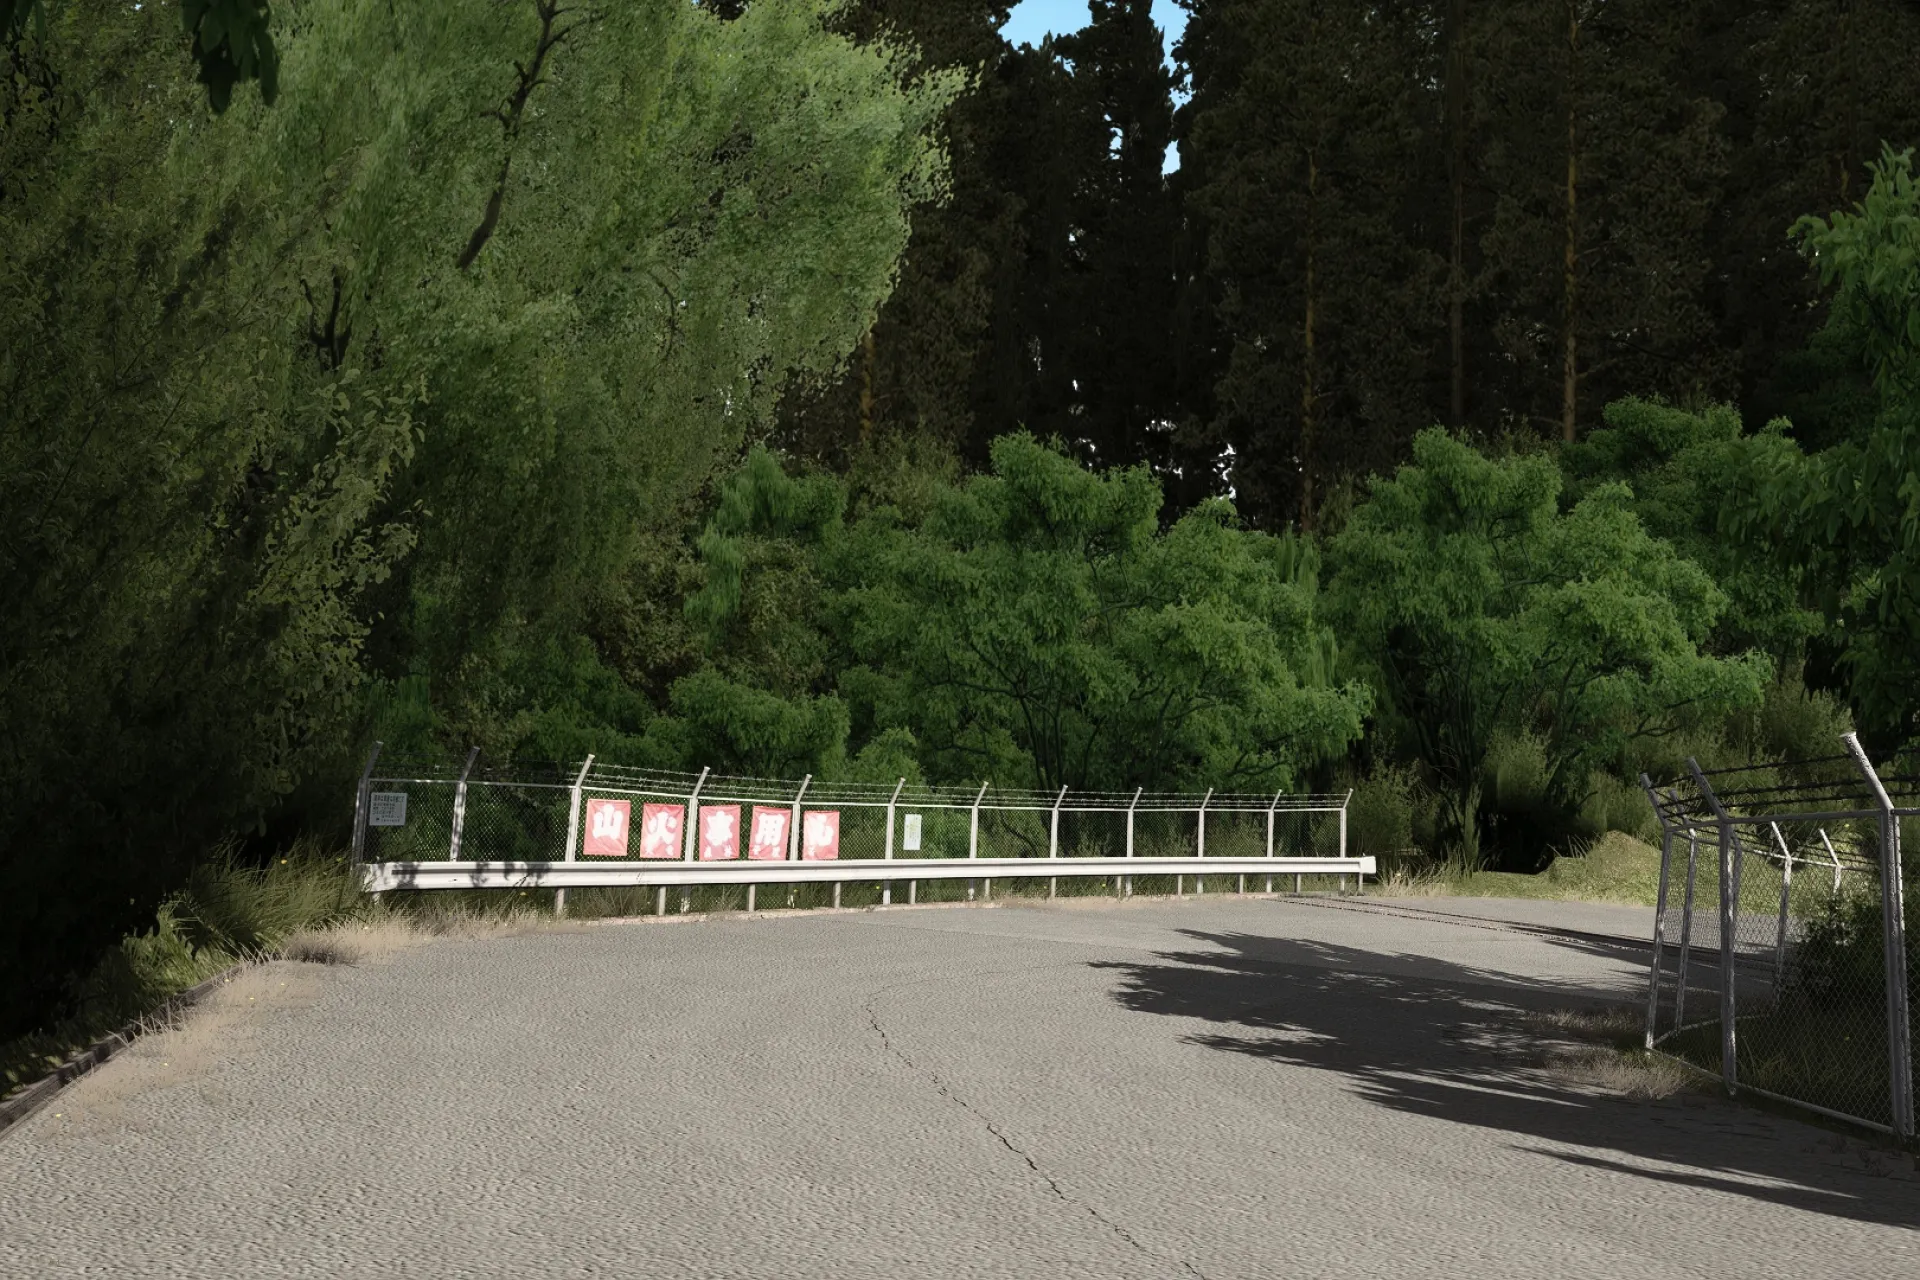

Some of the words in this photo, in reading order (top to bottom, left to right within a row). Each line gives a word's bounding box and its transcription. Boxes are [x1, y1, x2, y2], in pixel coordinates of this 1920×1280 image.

[593, 804, 623, 839] 山
[645, 811, 677, 847] 火
[755, 813, 785, 845] 用
